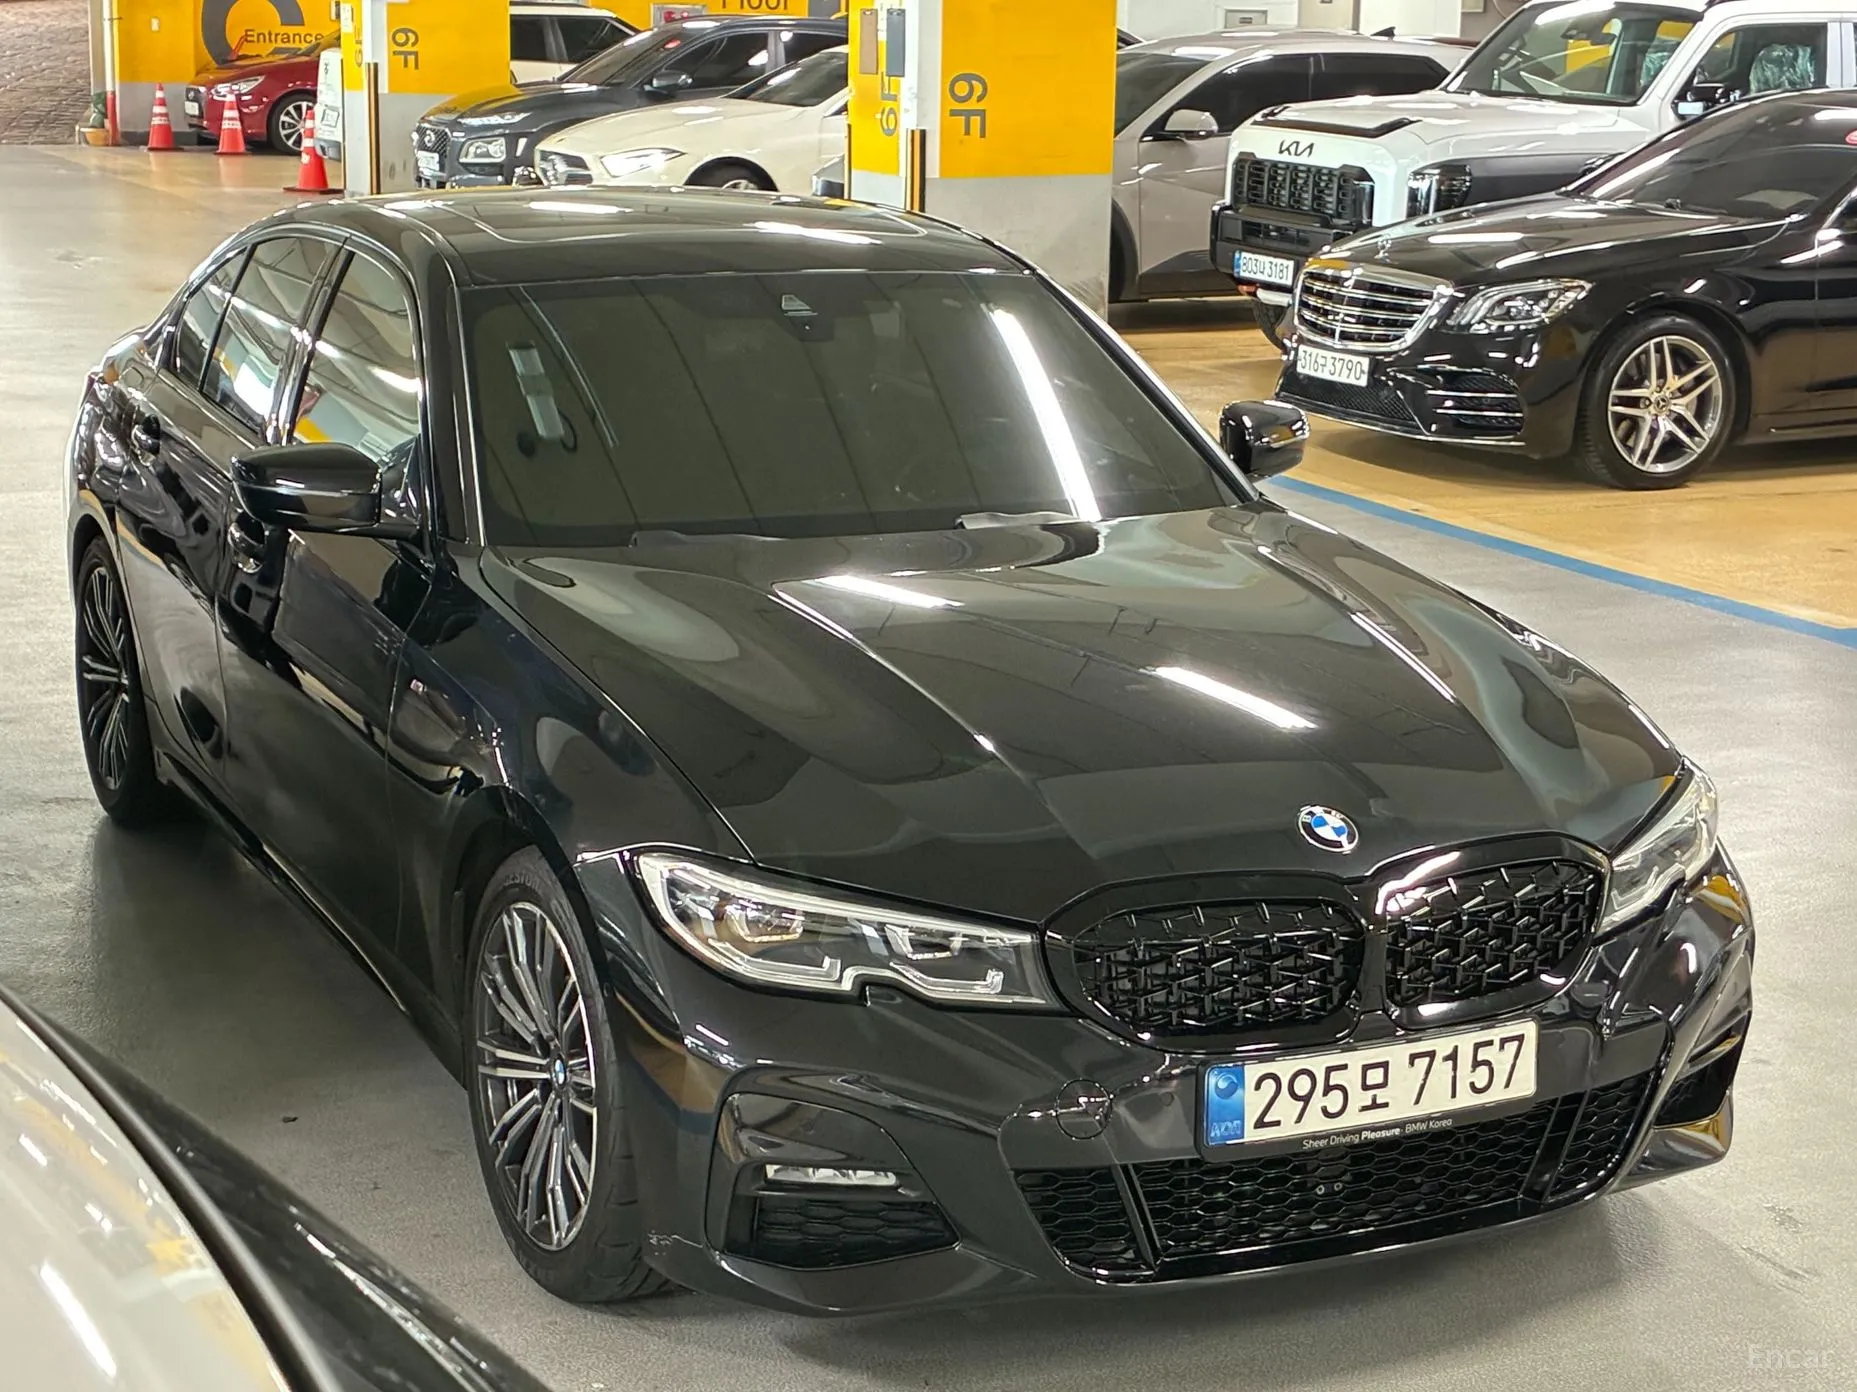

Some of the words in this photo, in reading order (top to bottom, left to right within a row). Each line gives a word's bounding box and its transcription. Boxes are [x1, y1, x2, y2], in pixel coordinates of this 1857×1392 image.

[244, 29, 324, 44] Entrance
[392, 27, 419, 70] 6F
[881, 71, 897, 136] 6F
[948, 72, 988, 138] 6F
[1267, 260, 1290, 281] 3181
[1329, 356, 1363, 380] 3790
[1253, 1060, 1390, 1129] 295모
[1408, 1033, 1526, 1106] 7157
[1302, 1138, 1329, 1150] Sheer
[1330, 1132, 1360, 1145] Driving
[1361, 1127, 1401, 1140] Pleasure
[1405, 1120, 1428, 1133] BMW
[1429, 1118, 1453, 1129] Korea
